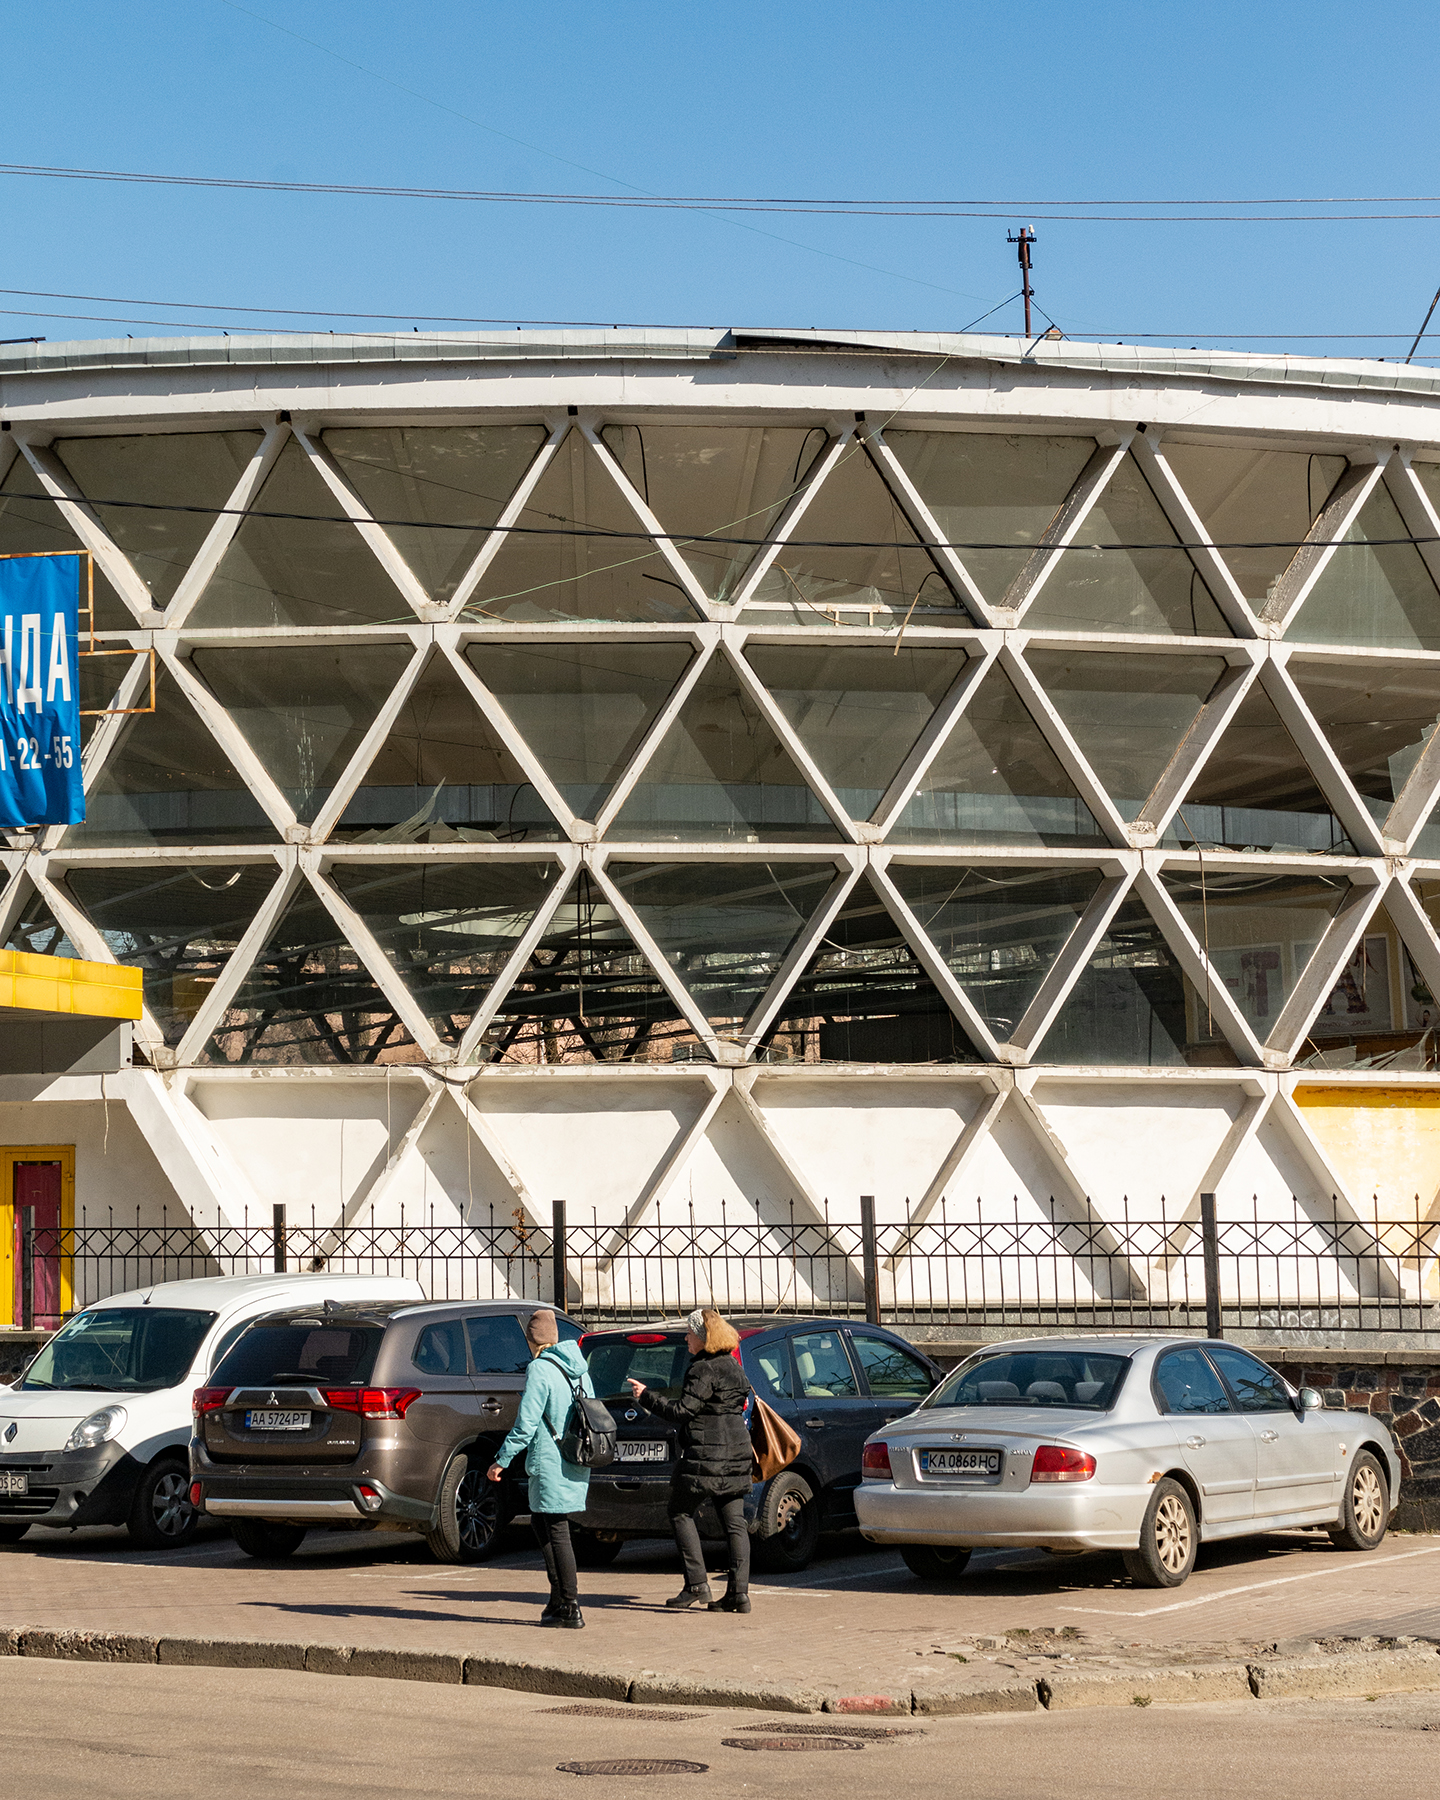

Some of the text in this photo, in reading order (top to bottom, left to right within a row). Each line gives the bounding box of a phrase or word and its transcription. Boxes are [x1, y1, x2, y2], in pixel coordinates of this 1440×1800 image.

[251, 1413, 308, 1425] AA 5724 PT
[622, 1443, 646, 1456] 7070
[648, 1443, 664, 1456] HP
[929, 1454, 997, 1469] KA 0868 HC
[10, 1477, 24, 1489] PC
